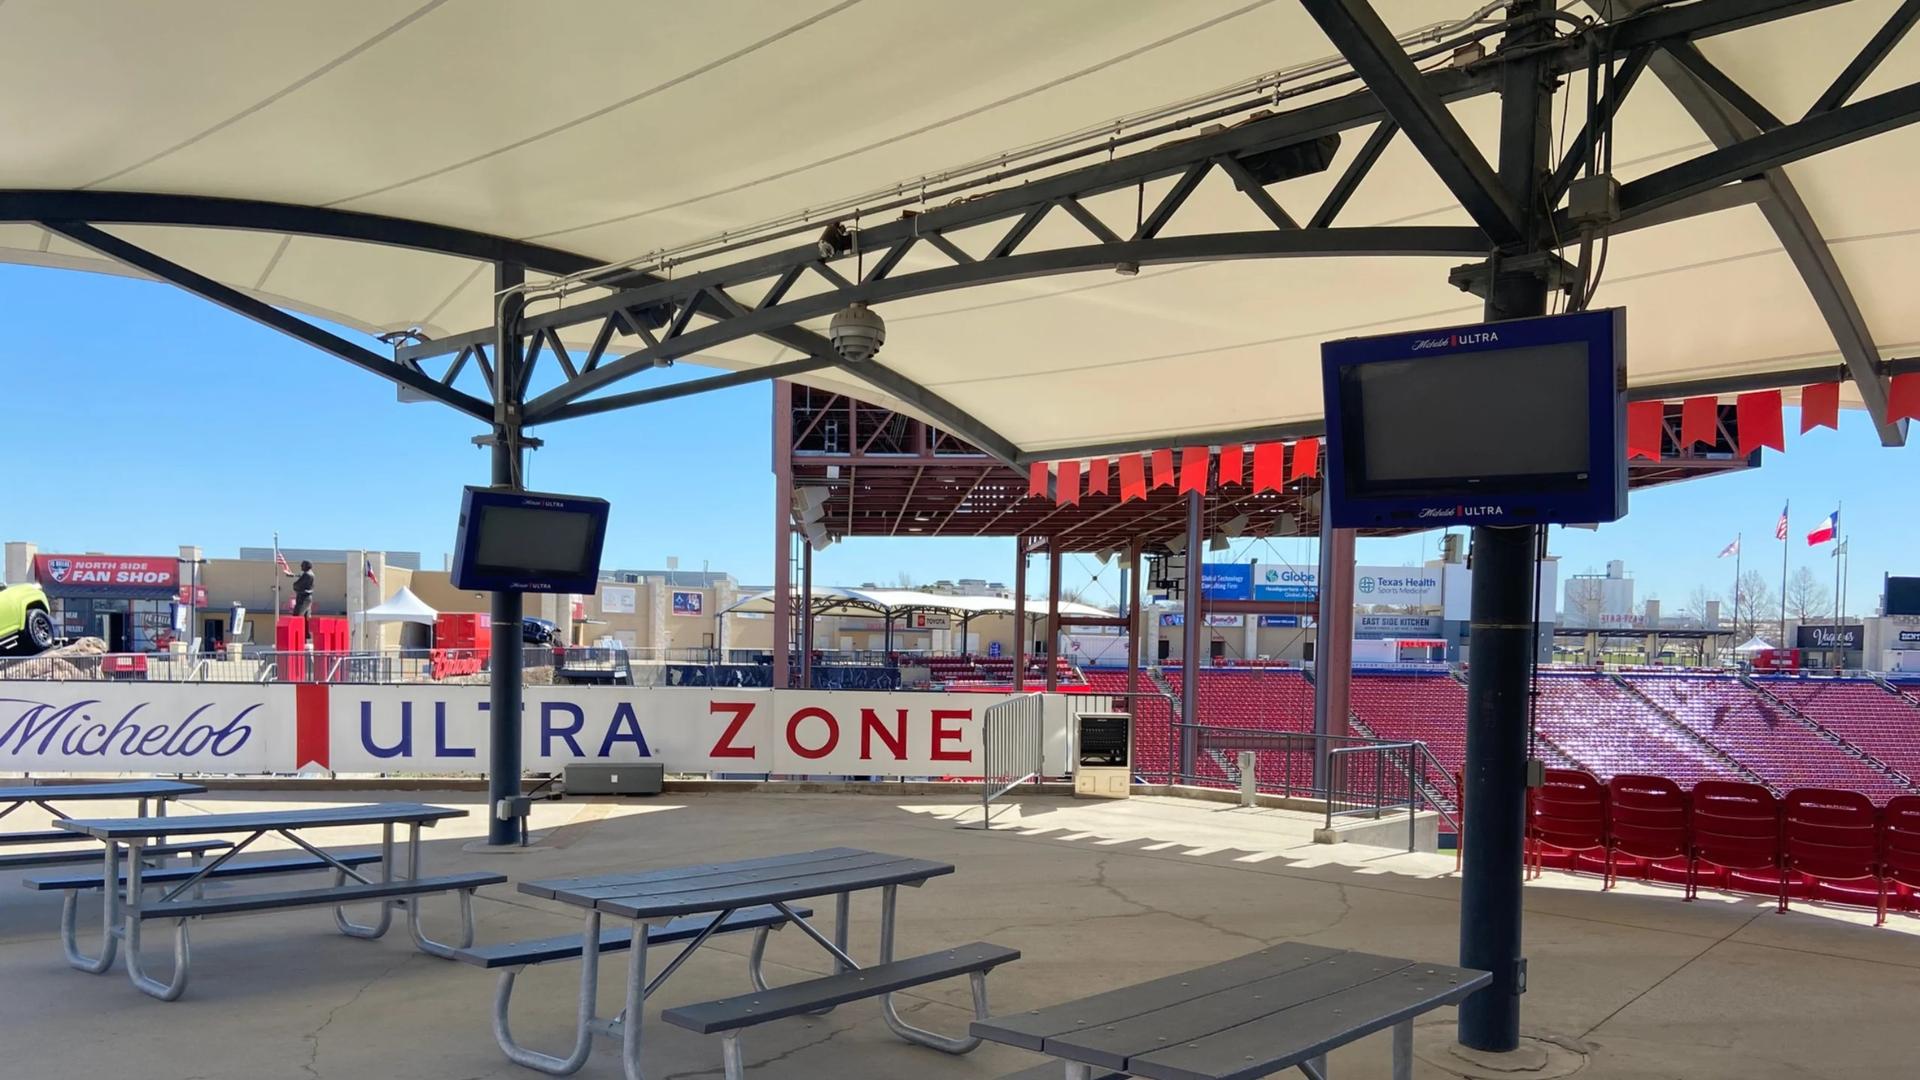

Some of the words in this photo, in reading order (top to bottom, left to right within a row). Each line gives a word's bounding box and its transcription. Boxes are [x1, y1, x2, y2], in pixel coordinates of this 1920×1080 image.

[1411, 336, 1449, 351] Michelob
[1459, 332, 1499, 345] ULTRA
[1464, 506, 1503, 516] ULTRA
[75, 562, 116, 570] NORTH
[72, 571, 111, 582] FAN
[116, 572, 170, 583] SHOP
[1217, 575, 1244, 584] Technology
[1281, 571, 1315, 582] Globe
[1201, 583, 1226, 591] Conulting
[1377, 577, 1403, 587] Texas
[1405, 578, 1436, 587] Health
[926, 617, 945, 625] TOYOTA
[1362, 617, 1379, 626] EAST
[1382, 618, 1398, 626] SIDE
[1400, 618, 1430, 626] KITCHEN
[1812, 628, 1855, 646] Vaqeos
[0, 698, 264, 757] Michelob
[360, 701, 652, 758] ULRA
[709, 700, 973, 763] ZONE
